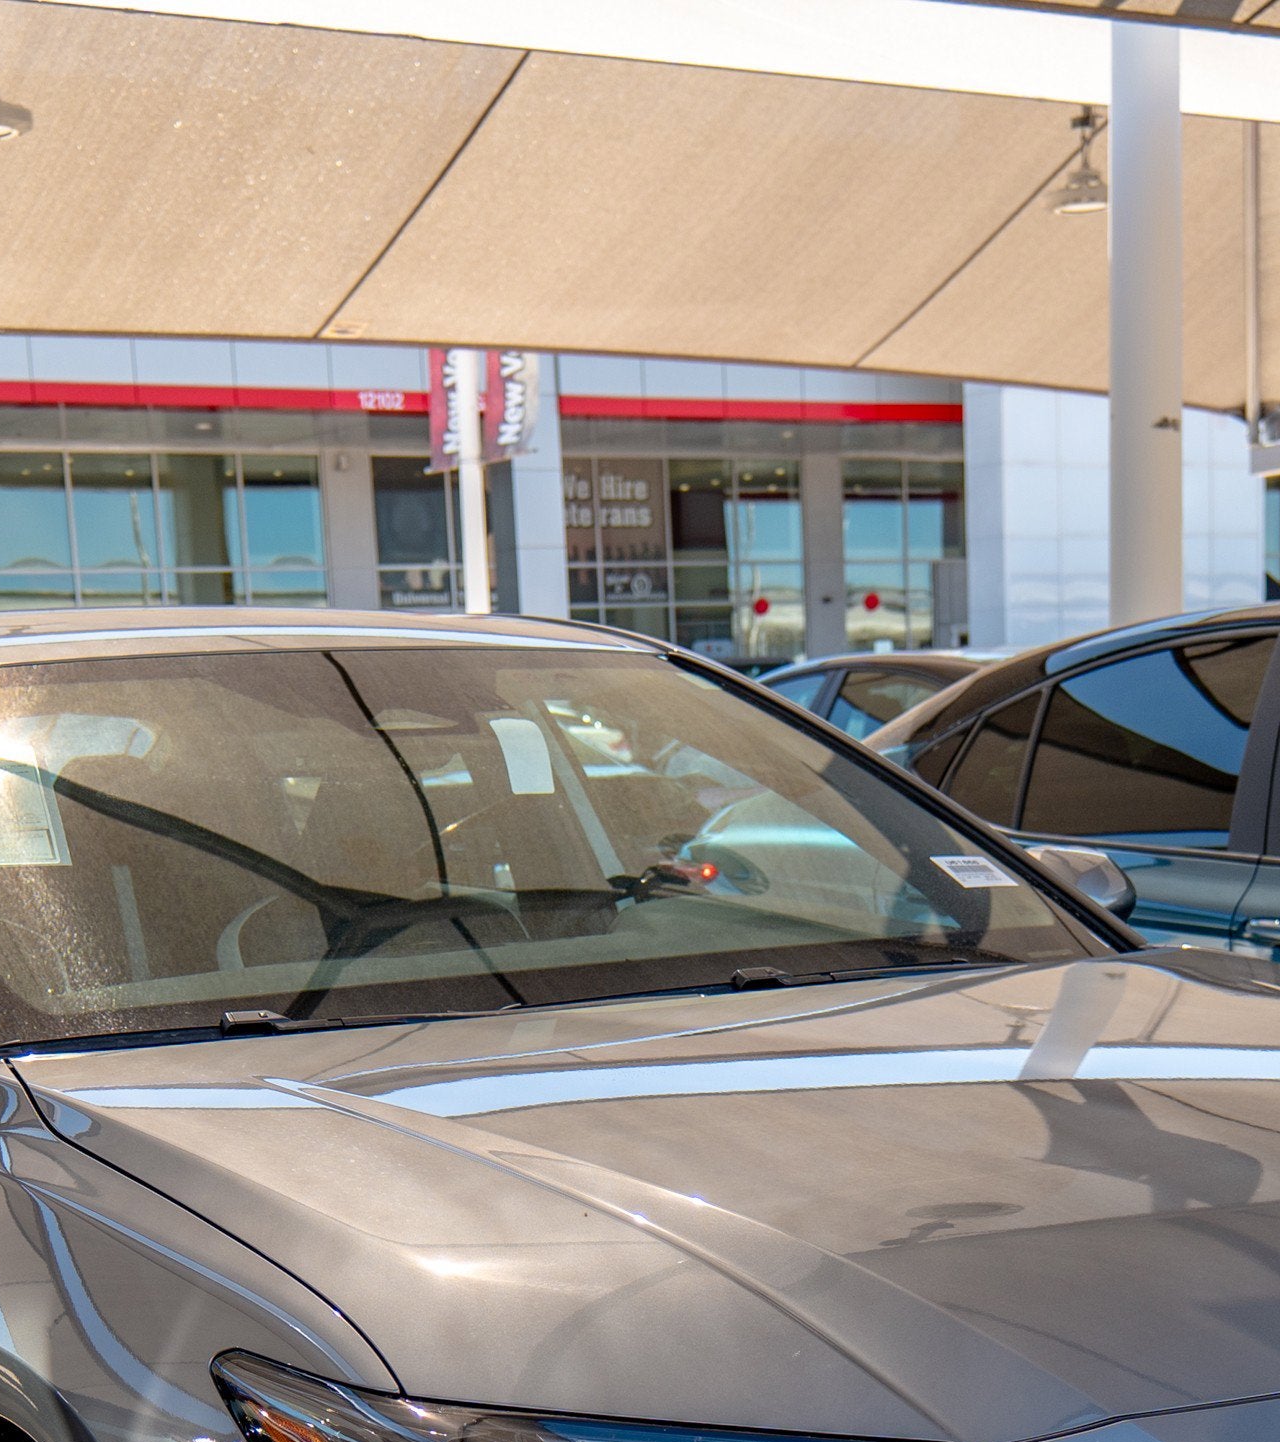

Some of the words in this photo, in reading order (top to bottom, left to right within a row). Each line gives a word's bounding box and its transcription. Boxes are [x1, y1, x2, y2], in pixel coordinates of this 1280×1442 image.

[500, 351, 524, 378] V
[358, 391, 406, 410] 12102
[497, 380, 526, 446] New
[600, 474, 649, 500] Hire
